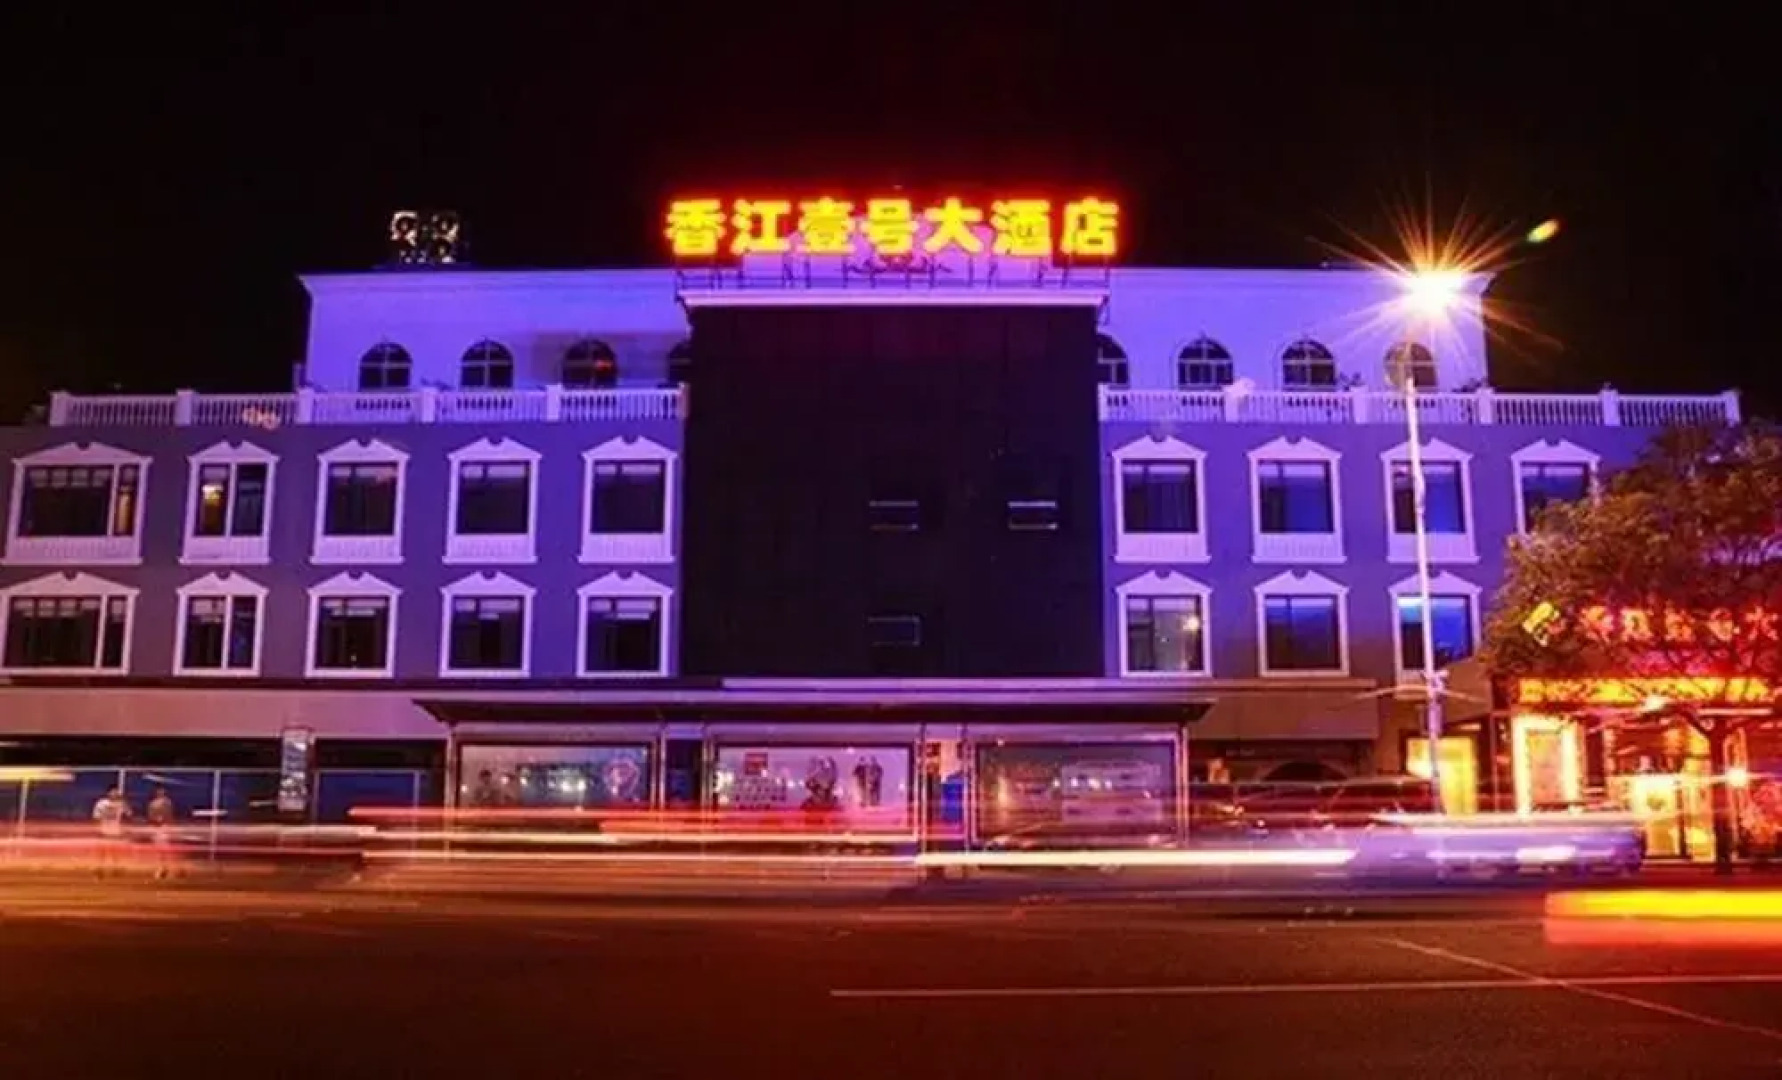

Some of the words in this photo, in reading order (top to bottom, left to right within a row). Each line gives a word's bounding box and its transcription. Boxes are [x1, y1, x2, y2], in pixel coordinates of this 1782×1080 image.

[666, 197, 1119, 257] 香江壹号大酒店
